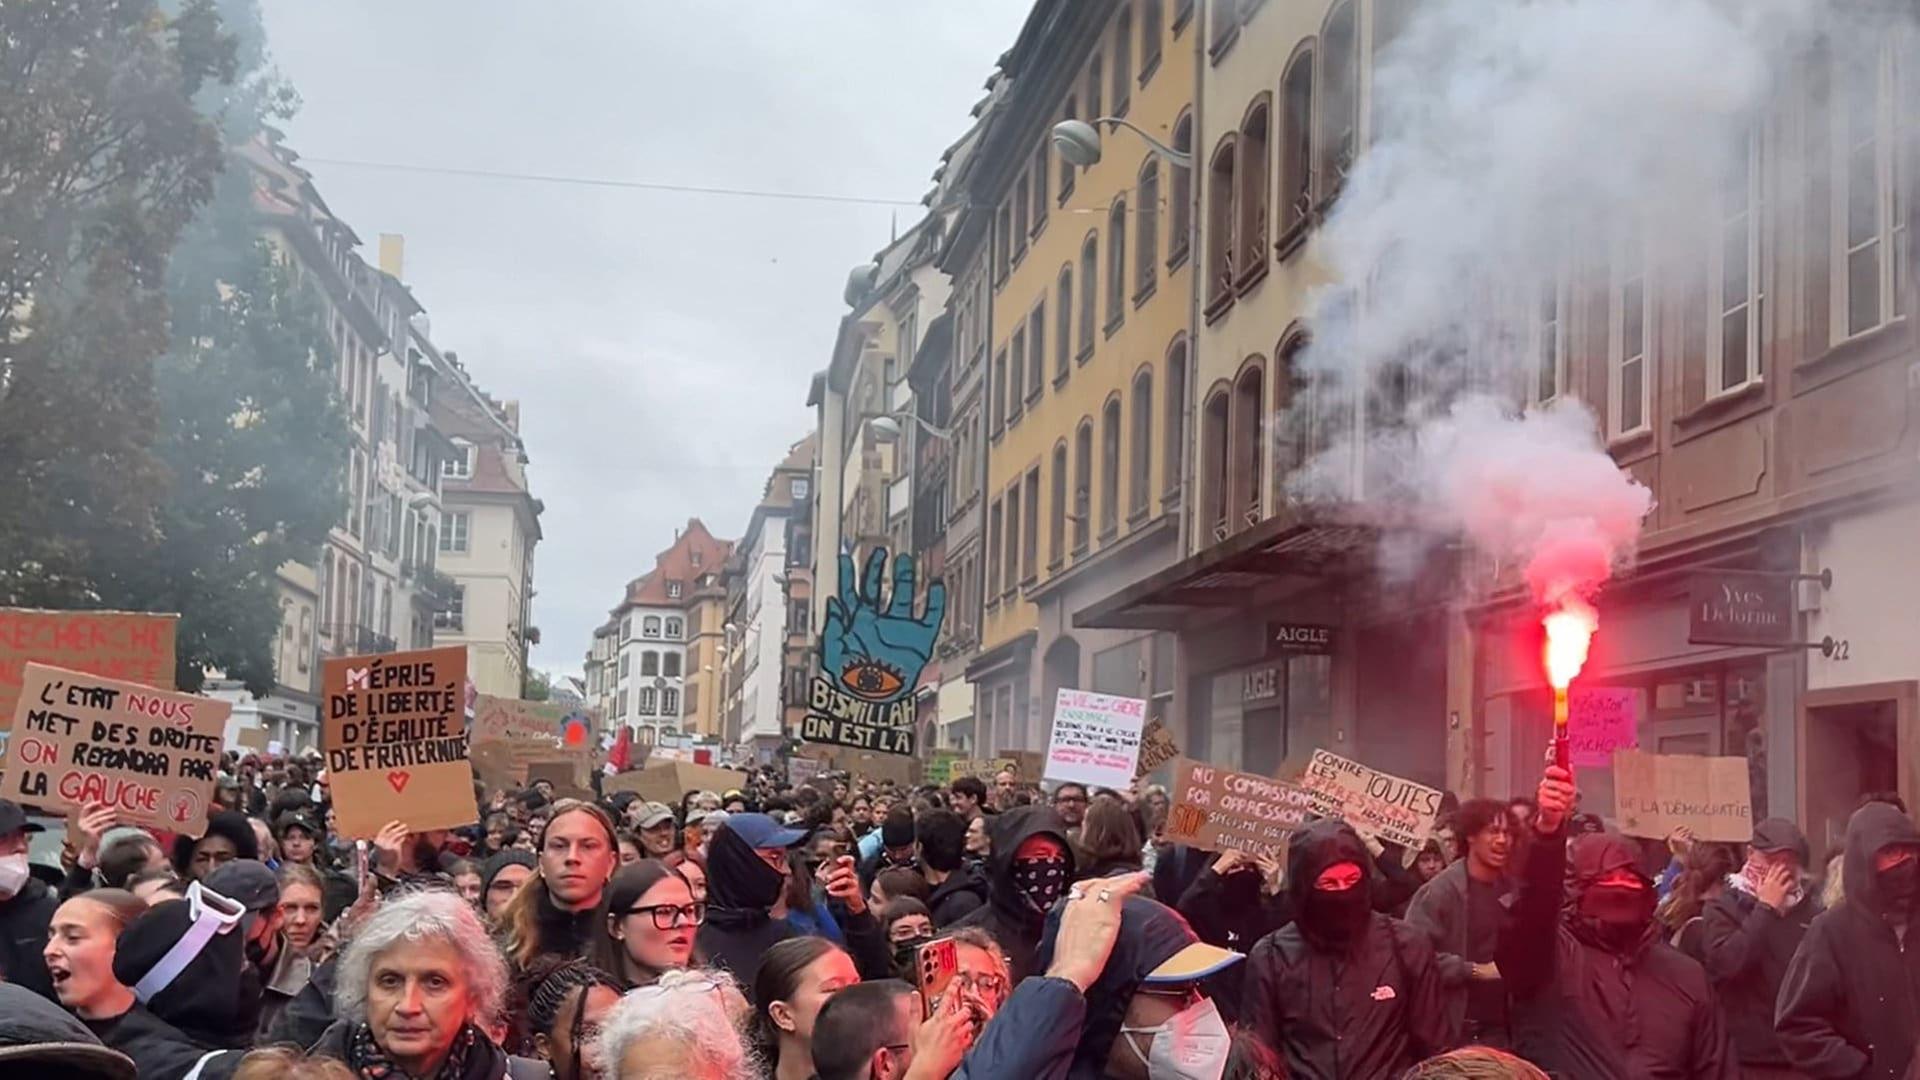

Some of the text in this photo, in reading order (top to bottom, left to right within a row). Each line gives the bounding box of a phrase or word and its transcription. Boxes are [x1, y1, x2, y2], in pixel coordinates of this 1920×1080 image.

[1276, 626, 1329, 643] AIGLE
[1833, 640, 1849, 661] 22
[346, 658, 436, 691] MÉPRIS
[1244, 668, 1277, 700] AIGLE
[127, 693, 195, 726] NOUS
[331, 683, 456, 719] DE LIBERTÉ
[26, 709, 80, 736] MET
[91, 721, 139, 745] DES
[804, 718, 834, 739] ON
[838, 722, 875, 747] EST
[20, 738, 59, 765] ON
[180, 758, 214, 781] PAR
[330, 748, 359, 774] DE
[1312, 763, 1337, 780] LES
[19, 769, 48, 797] LA
[58, 771, 162, 811] GAUCHE
[1314, 751, 1441, 816] CONTRE TOUTES
[1641, 800, 1659, 817] LA
